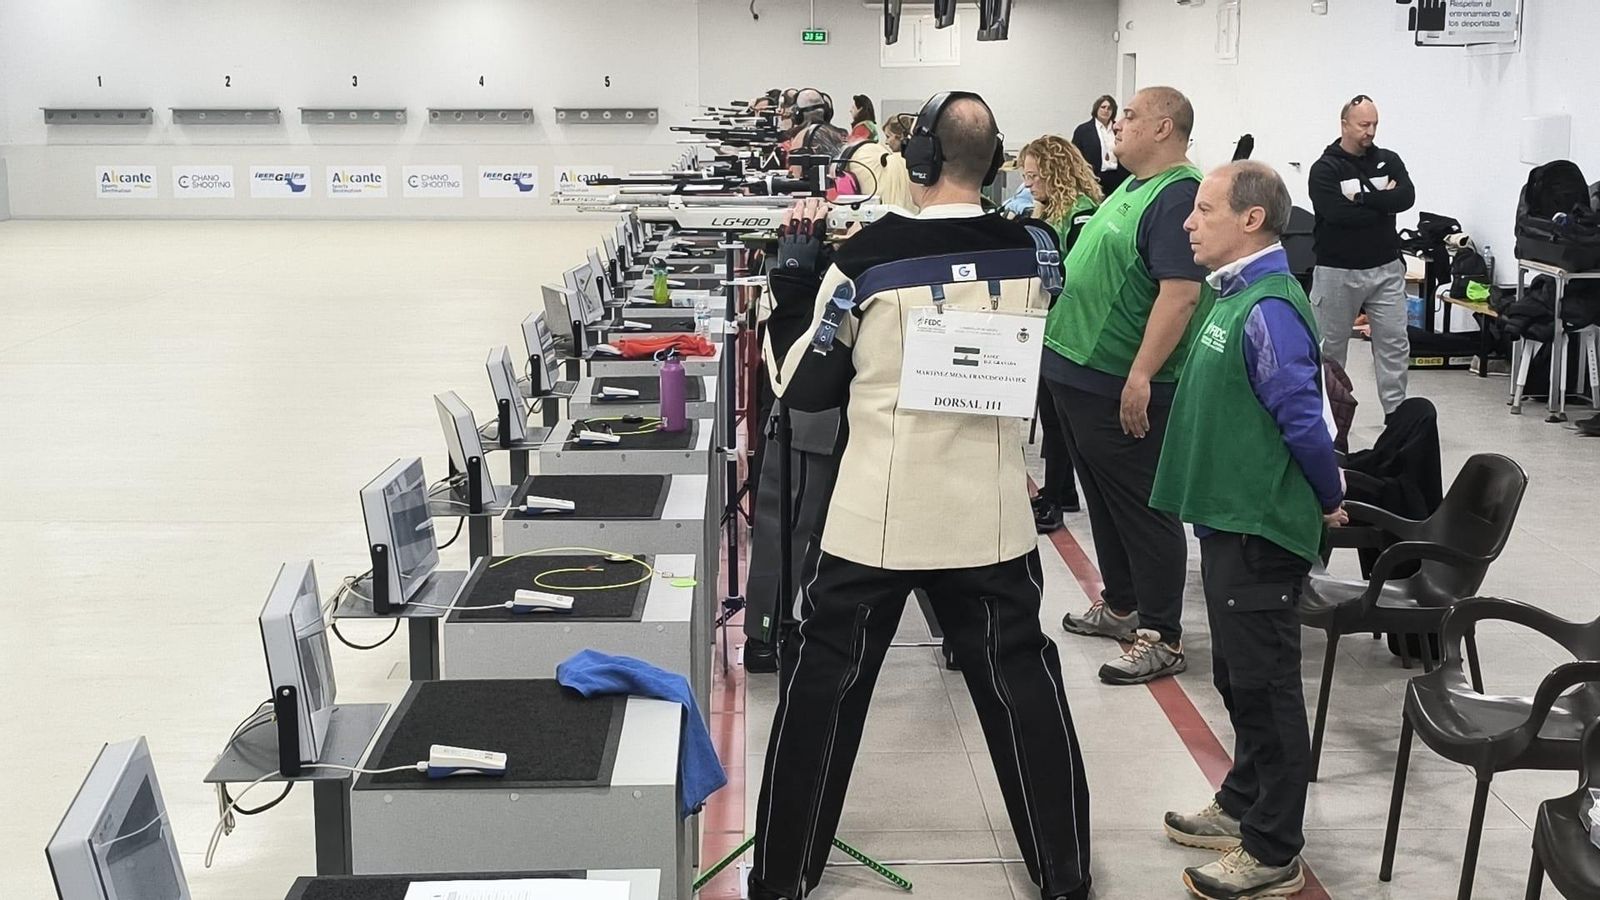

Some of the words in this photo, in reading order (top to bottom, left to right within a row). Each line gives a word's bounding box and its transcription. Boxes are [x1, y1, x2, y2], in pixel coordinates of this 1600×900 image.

[1461, 20, 1500, 28] deportistas
[97, 76, 102, 87] 1
[225, 76, 231, 87] 2
[352, 76, 358, 87] 3
[478, 76, 484, 87] 4
[604, 76, 610, 88] 5
[102, 169, 152, 183] Alicante
[332, 170, 382, 183] Alicante
[711, 217, 771, 227] LG400
[958, 266, 970, 277] G
[934, 396, 981, 409] DORSAL
[985, 399, 1001, 410] 111
